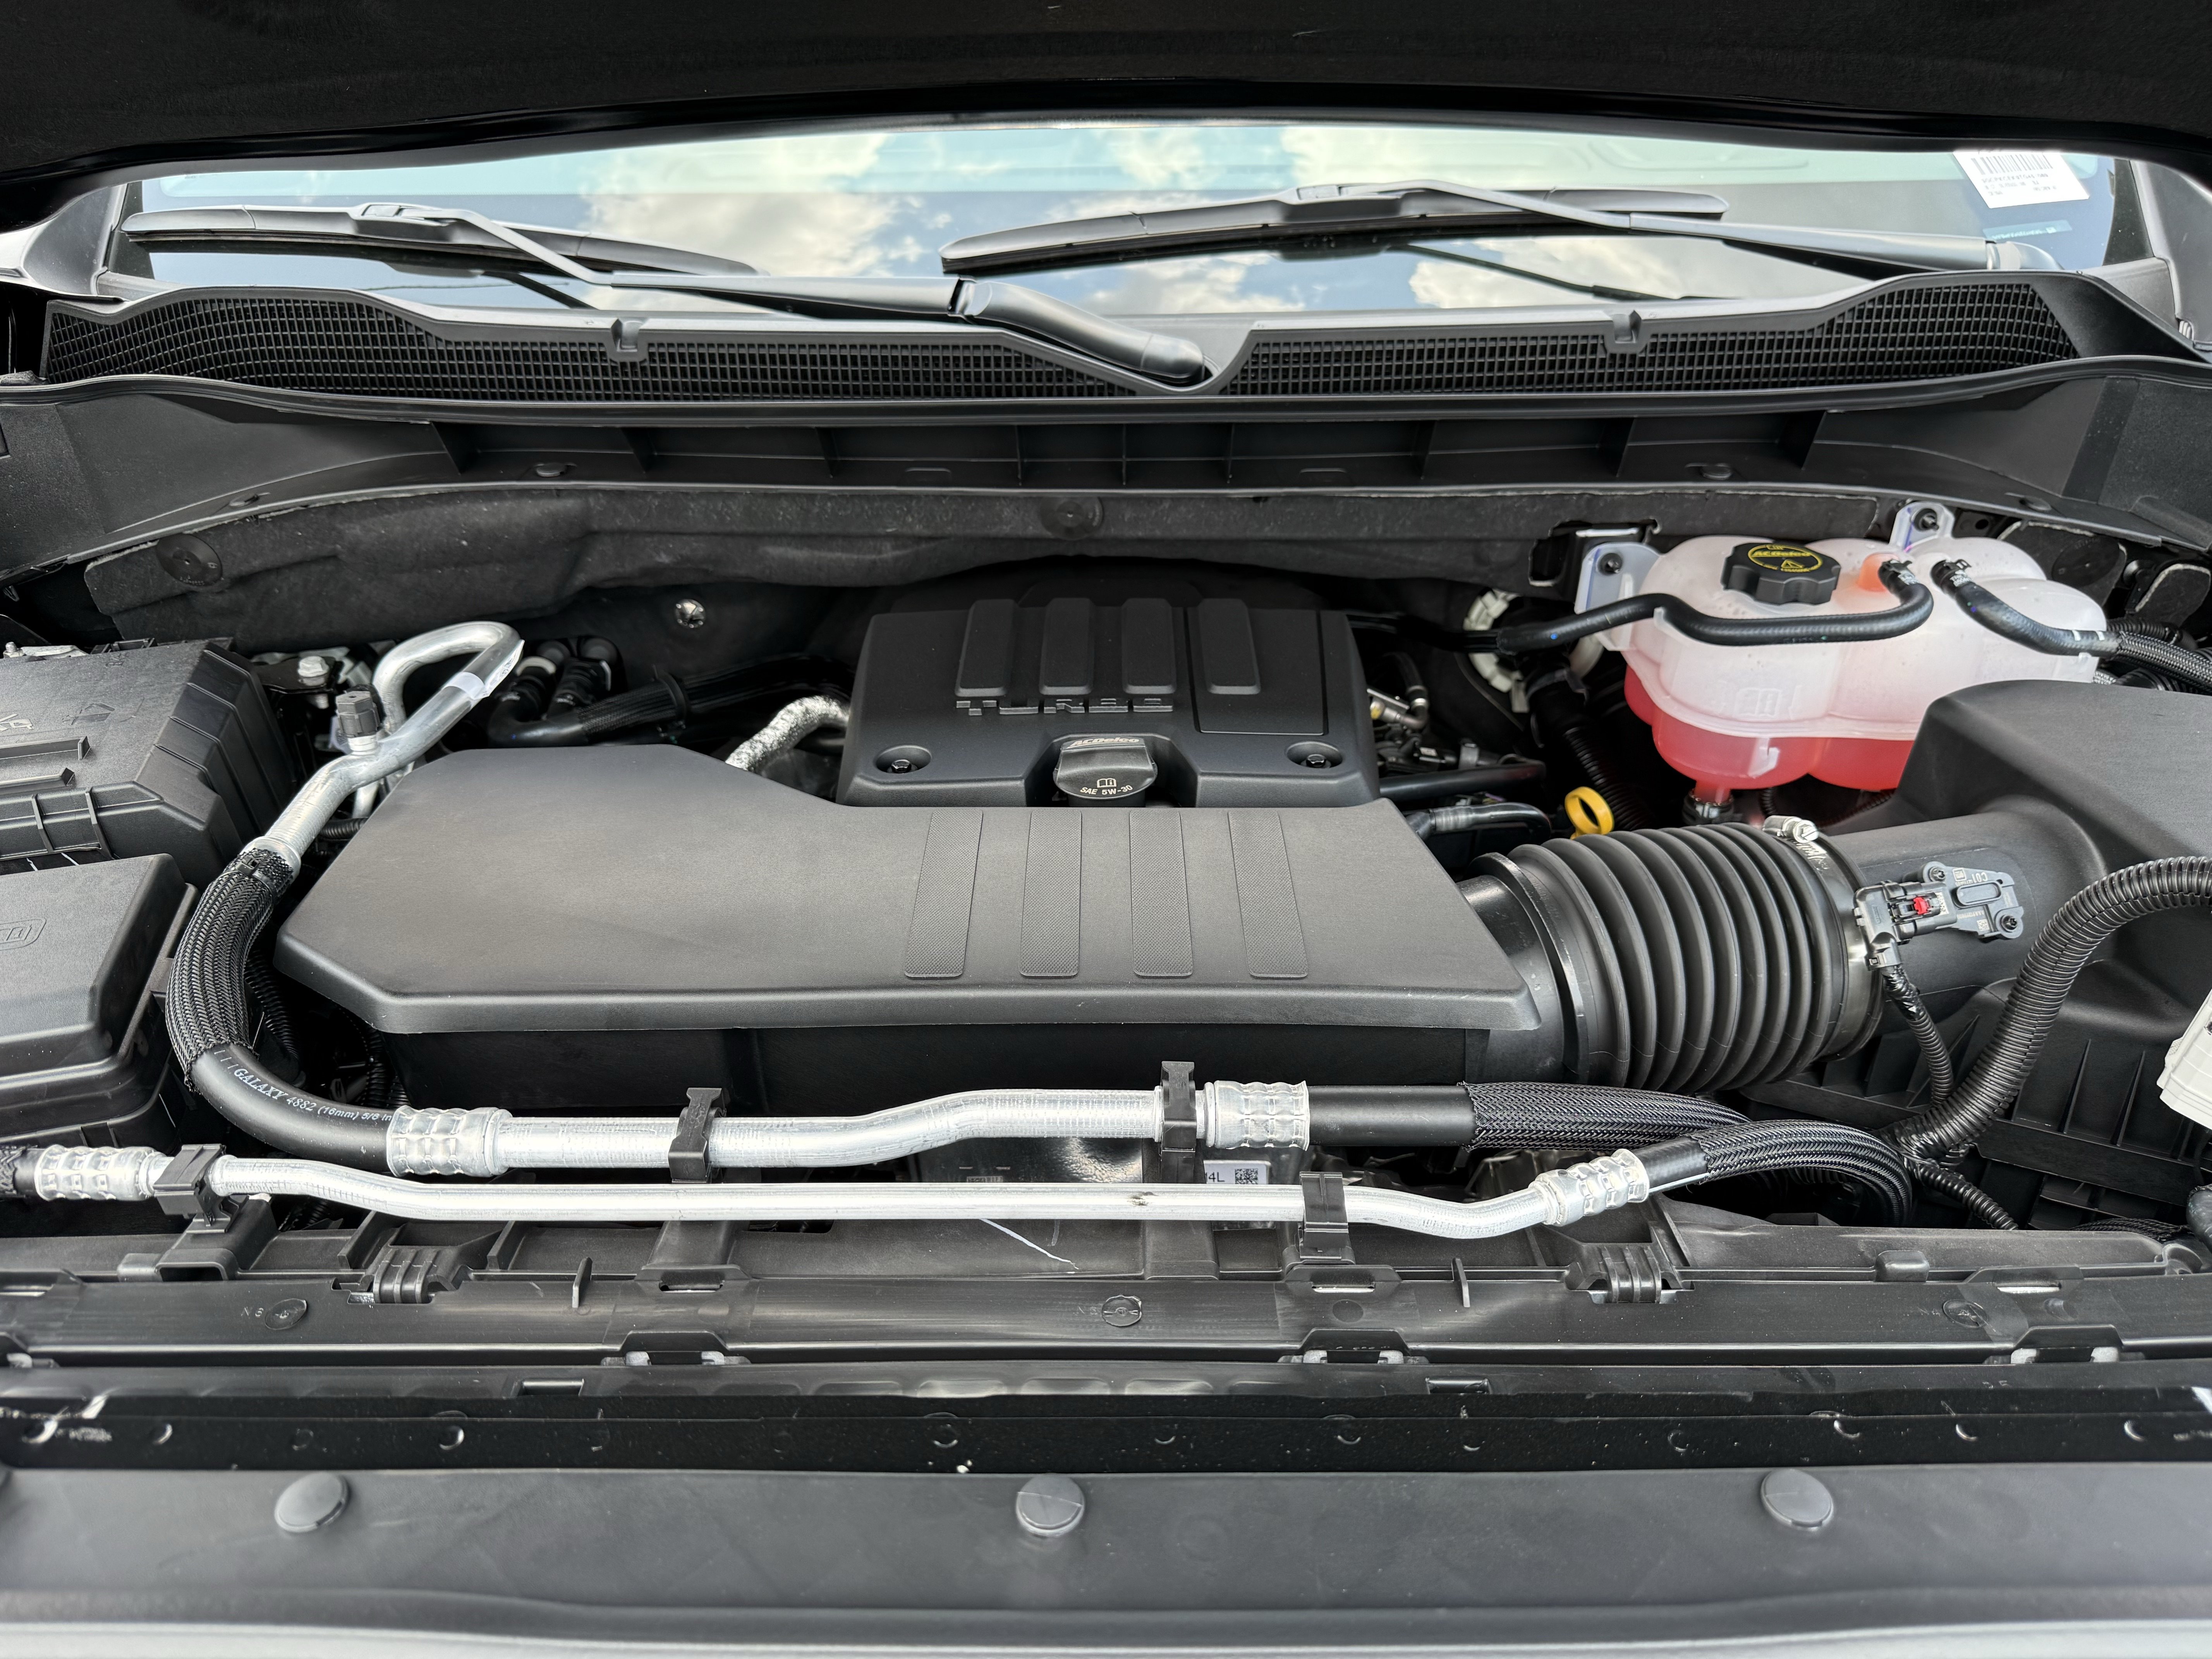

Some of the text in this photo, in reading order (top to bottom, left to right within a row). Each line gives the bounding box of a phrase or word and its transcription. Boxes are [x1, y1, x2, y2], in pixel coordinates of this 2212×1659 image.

[1068, 737, 1140, 748] ACDelco
[1080, 785, 1133, 795] SAE 5W-30
[234, 1068, 289, 1099] GALAXY
[287, 1097, 317, 1111] 4882
[318, 1106, 359, 1120] (16mm)
